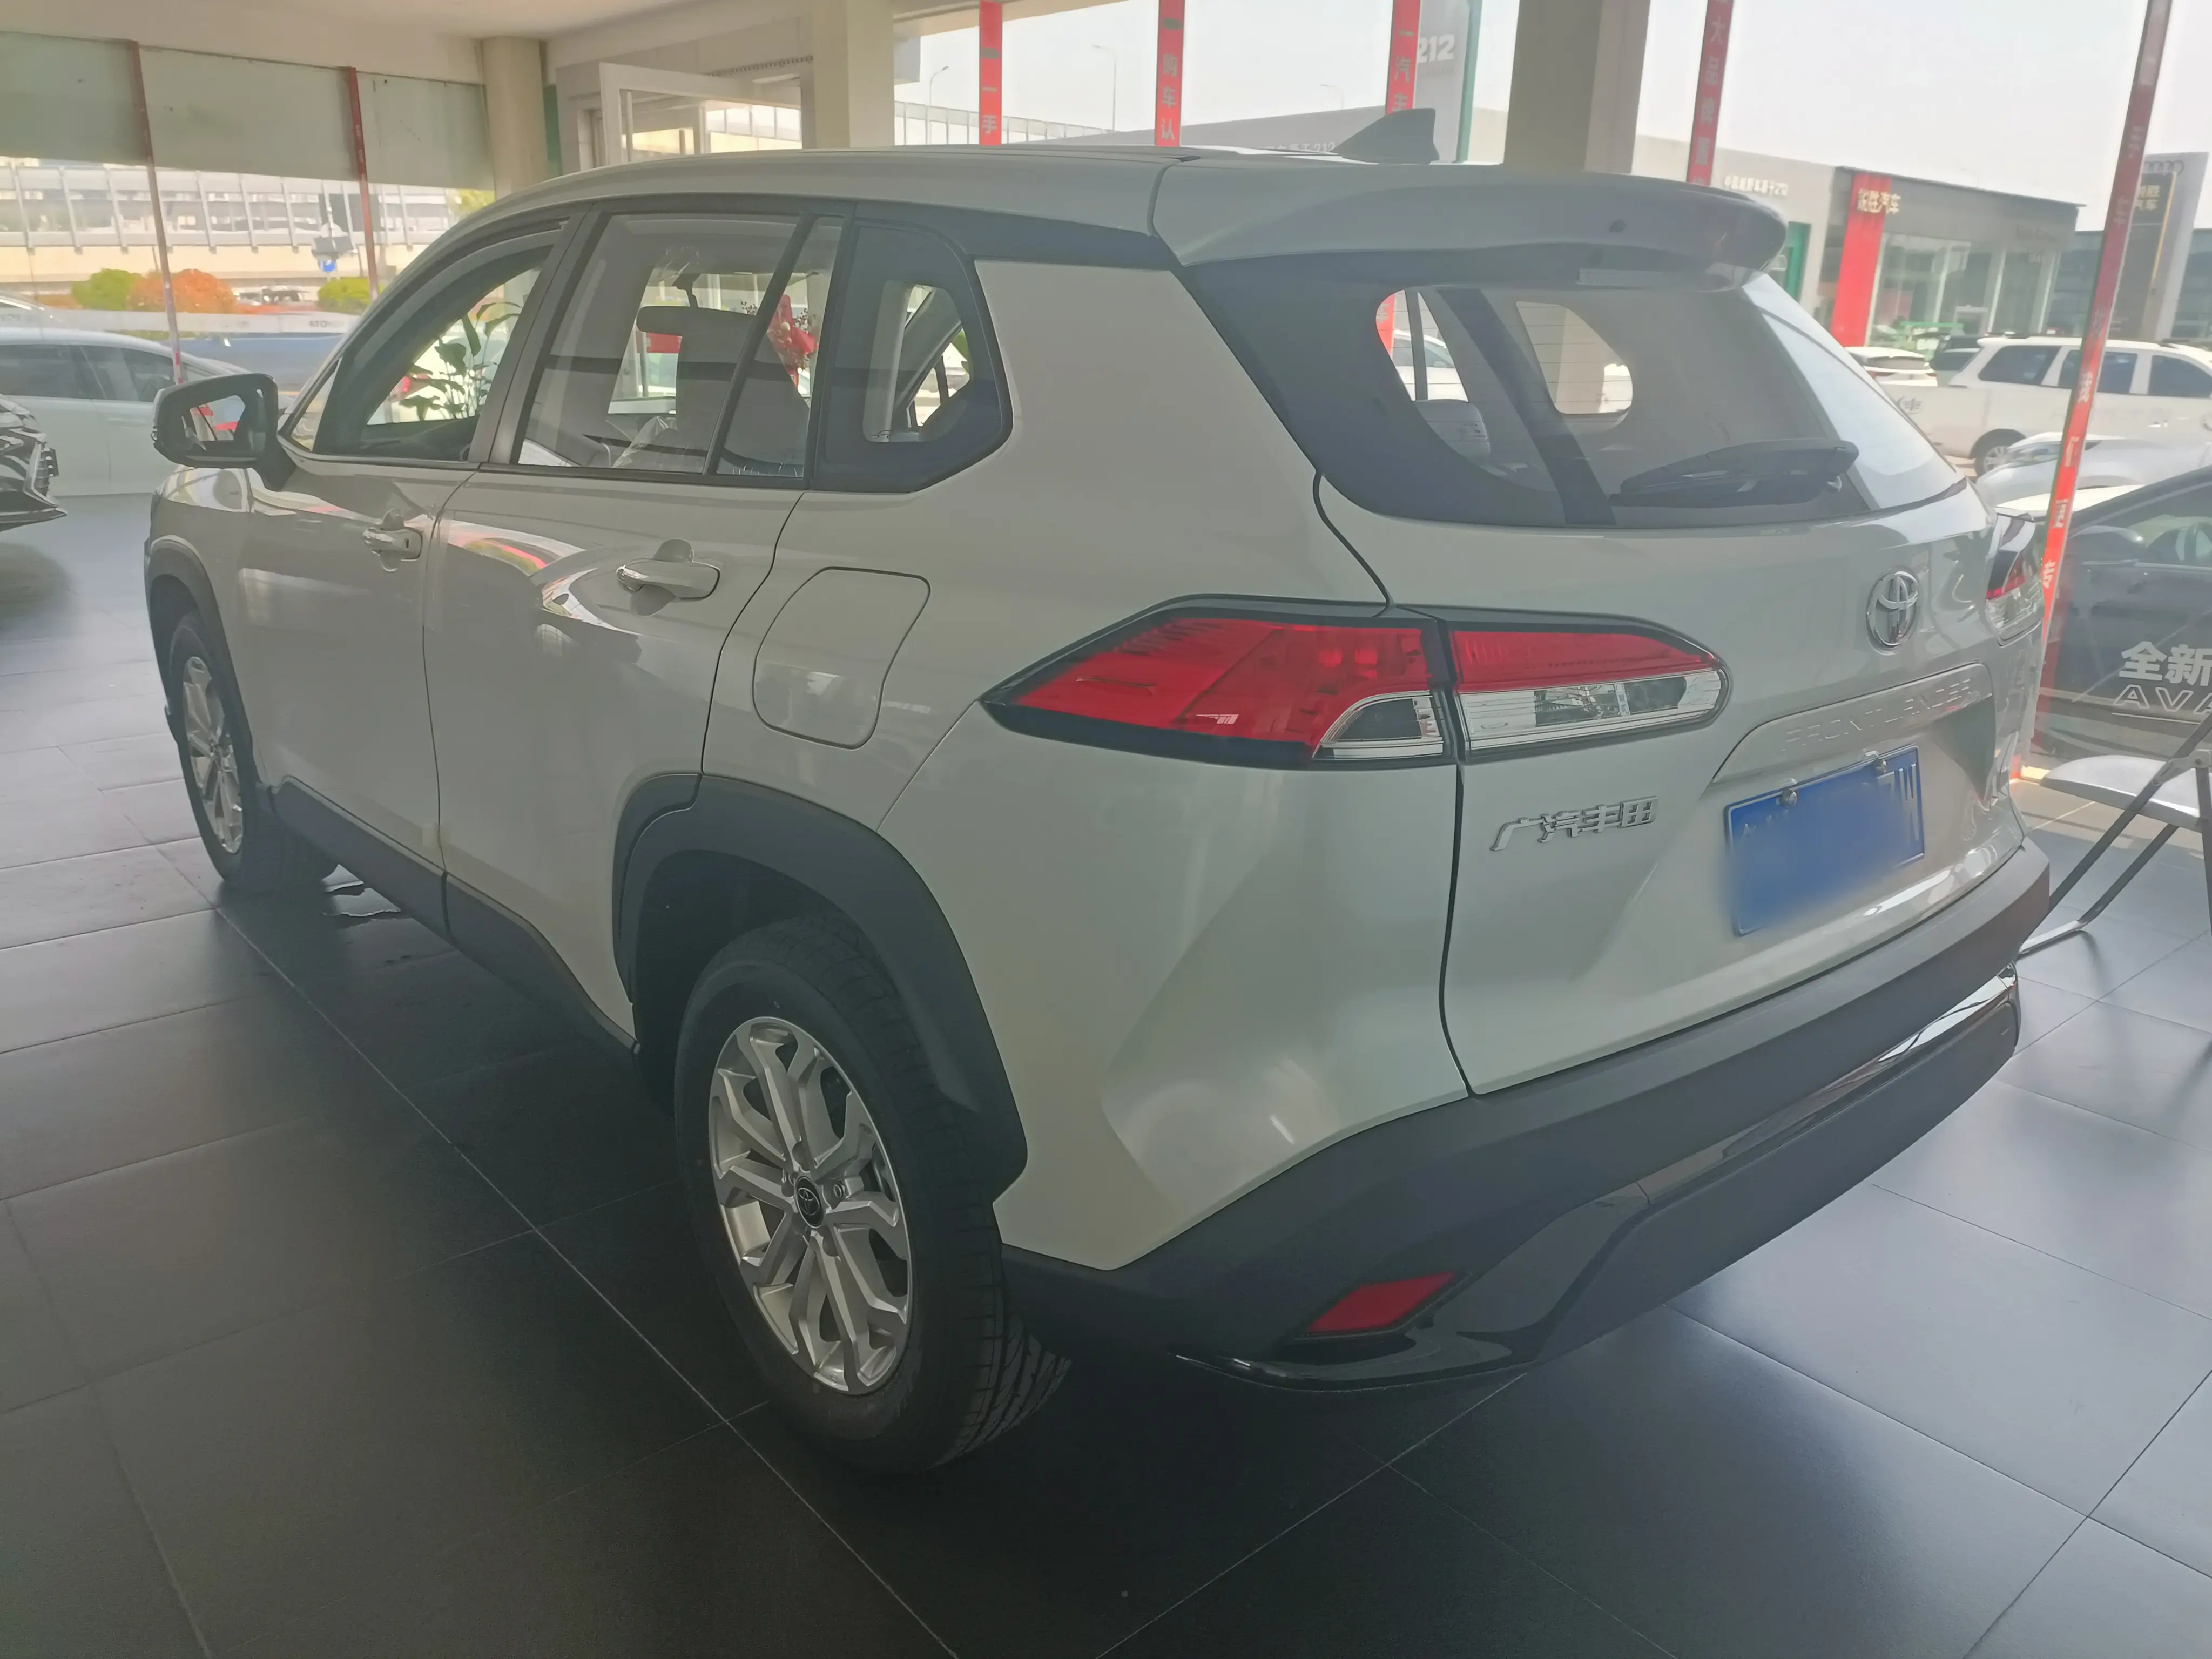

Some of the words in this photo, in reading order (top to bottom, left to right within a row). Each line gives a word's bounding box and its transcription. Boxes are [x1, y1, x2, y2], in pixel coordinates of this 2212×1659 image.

[1417, 34, 1455, 64] 212
[1161, 53, 1178, 141] 购车认
[2119, 640, 2212, 686] 全新
[1489, 795, 1658, 852] 广汽丰田
